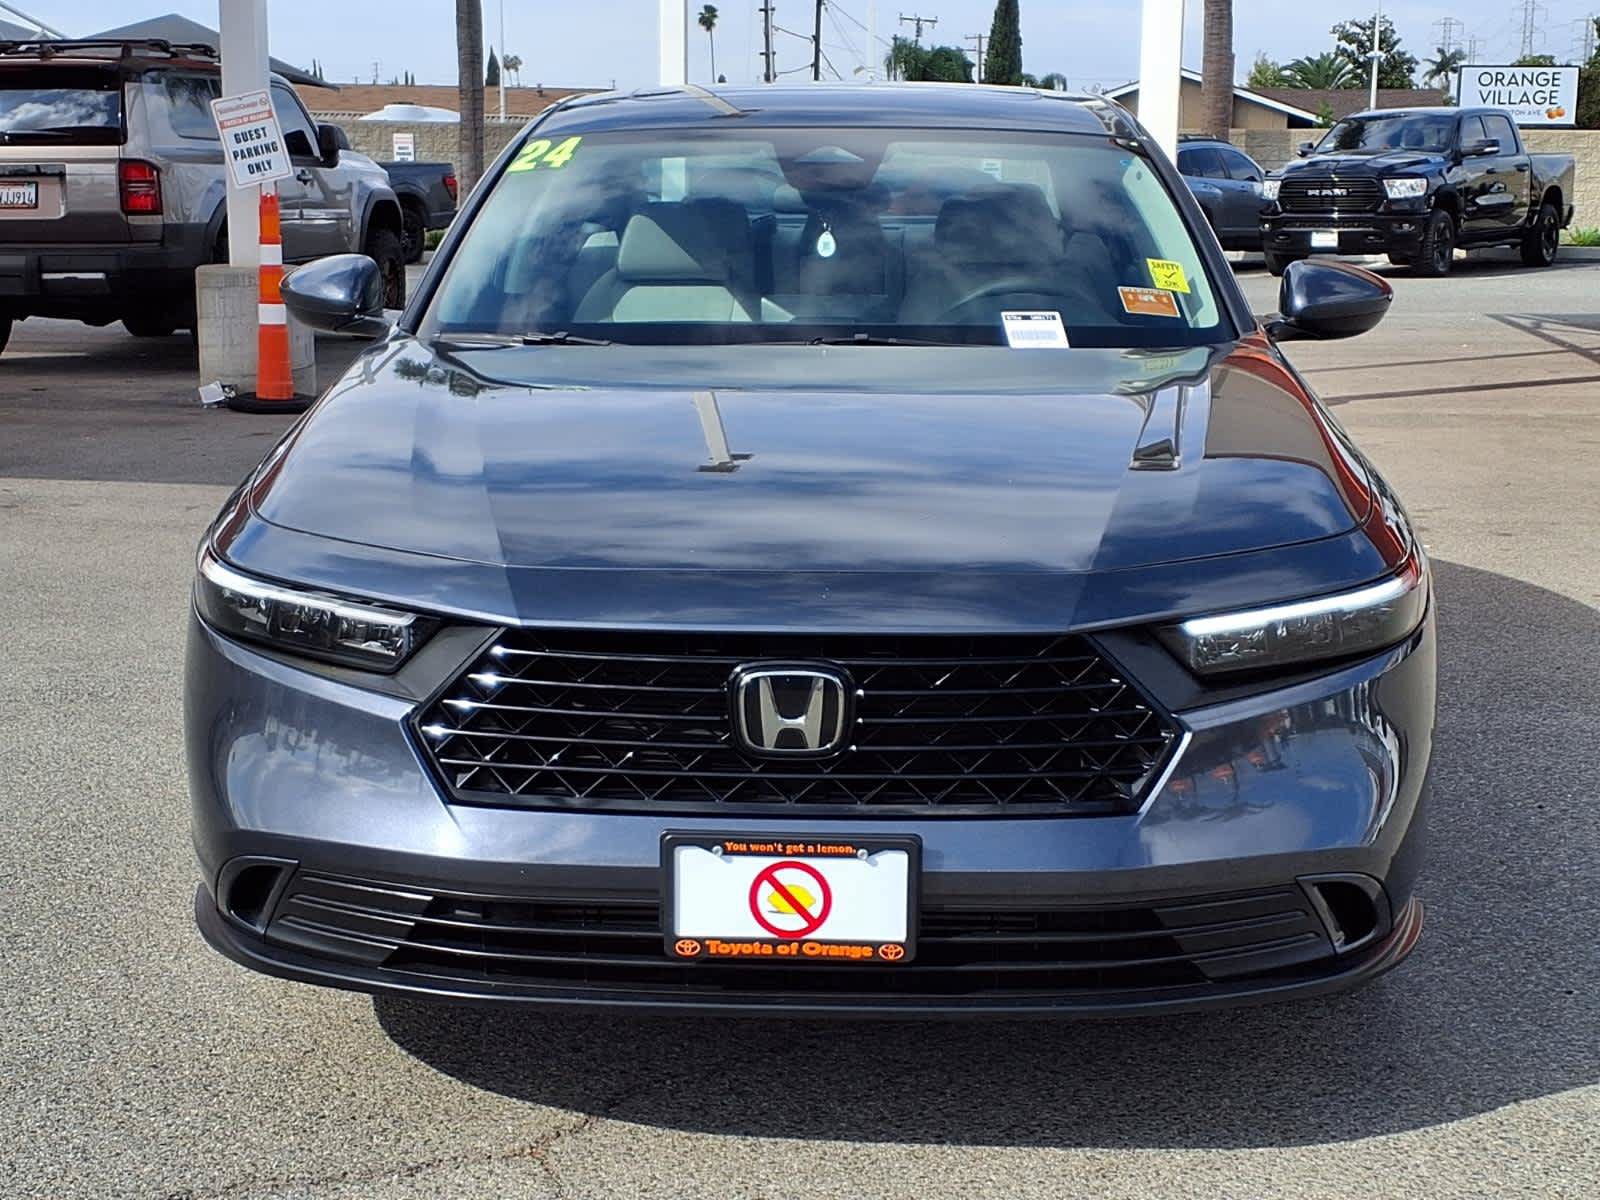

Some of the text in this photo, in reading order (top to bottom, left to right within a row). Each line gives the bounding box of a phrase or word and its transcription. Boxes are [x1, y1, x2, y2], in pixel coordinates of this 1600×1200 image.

[1478, 71, 1562, 87] ORANGE
[1478, 89, 1560, 105] VILLAGE
[234, 127, 267, 144] GUEST
[232, 141, 279, 161] PARKING
[507, 136, 583, 173] 24
[247, 159, 273, 175] ONLY
[1151, 261, 1180, 271] SAFETY
[724, 841, 857, 855] You won't get a lemon.
[705, 940, 874, 959] Toyota of Orange
